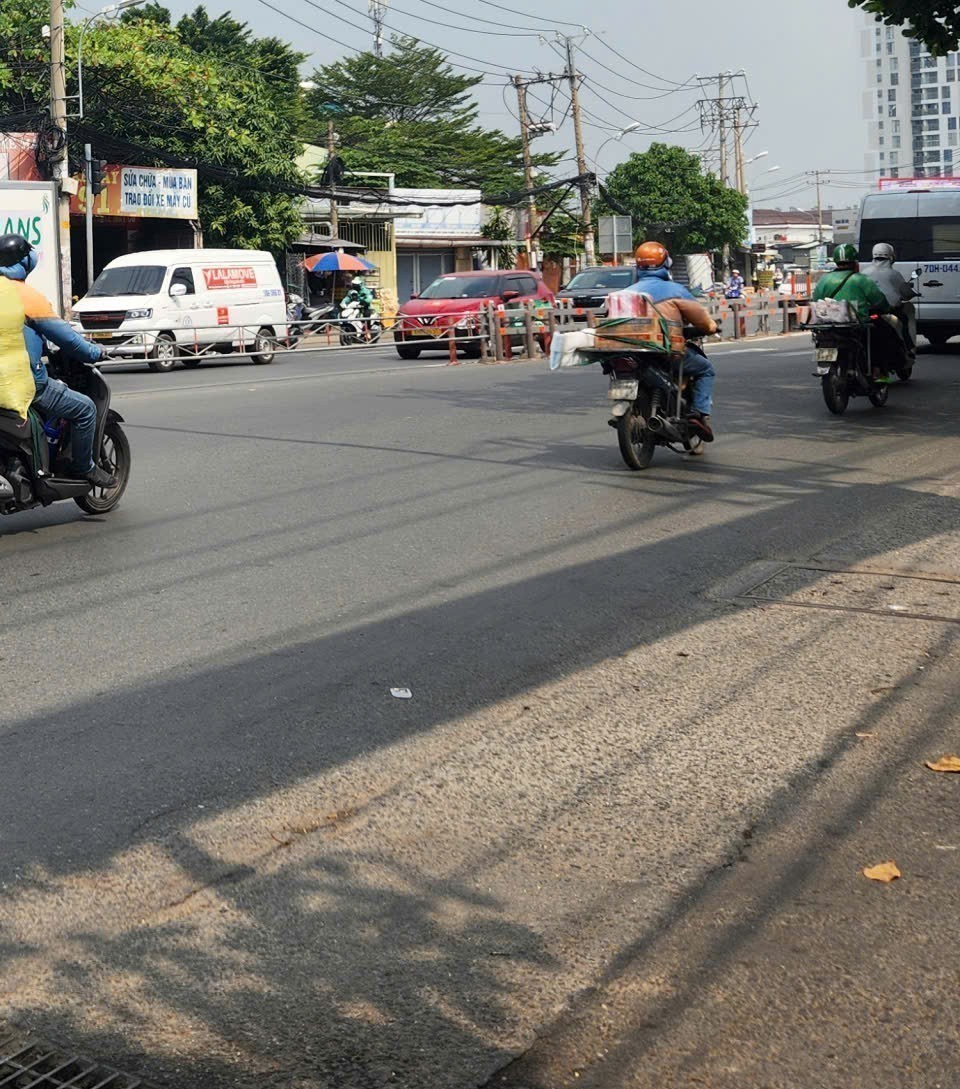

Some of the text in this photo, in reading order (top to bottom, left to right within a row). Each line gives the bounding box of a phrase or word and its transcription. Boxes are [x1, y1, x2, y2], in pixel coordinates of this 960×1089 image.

[124, 169, 137, 186] SỬA
[163, 175, 177, 189] MUA
[125, 192, 141, 205] TRAO
[156, 194, 165, 207] XE
[213, 268, 256, 280] LALAMOVE
